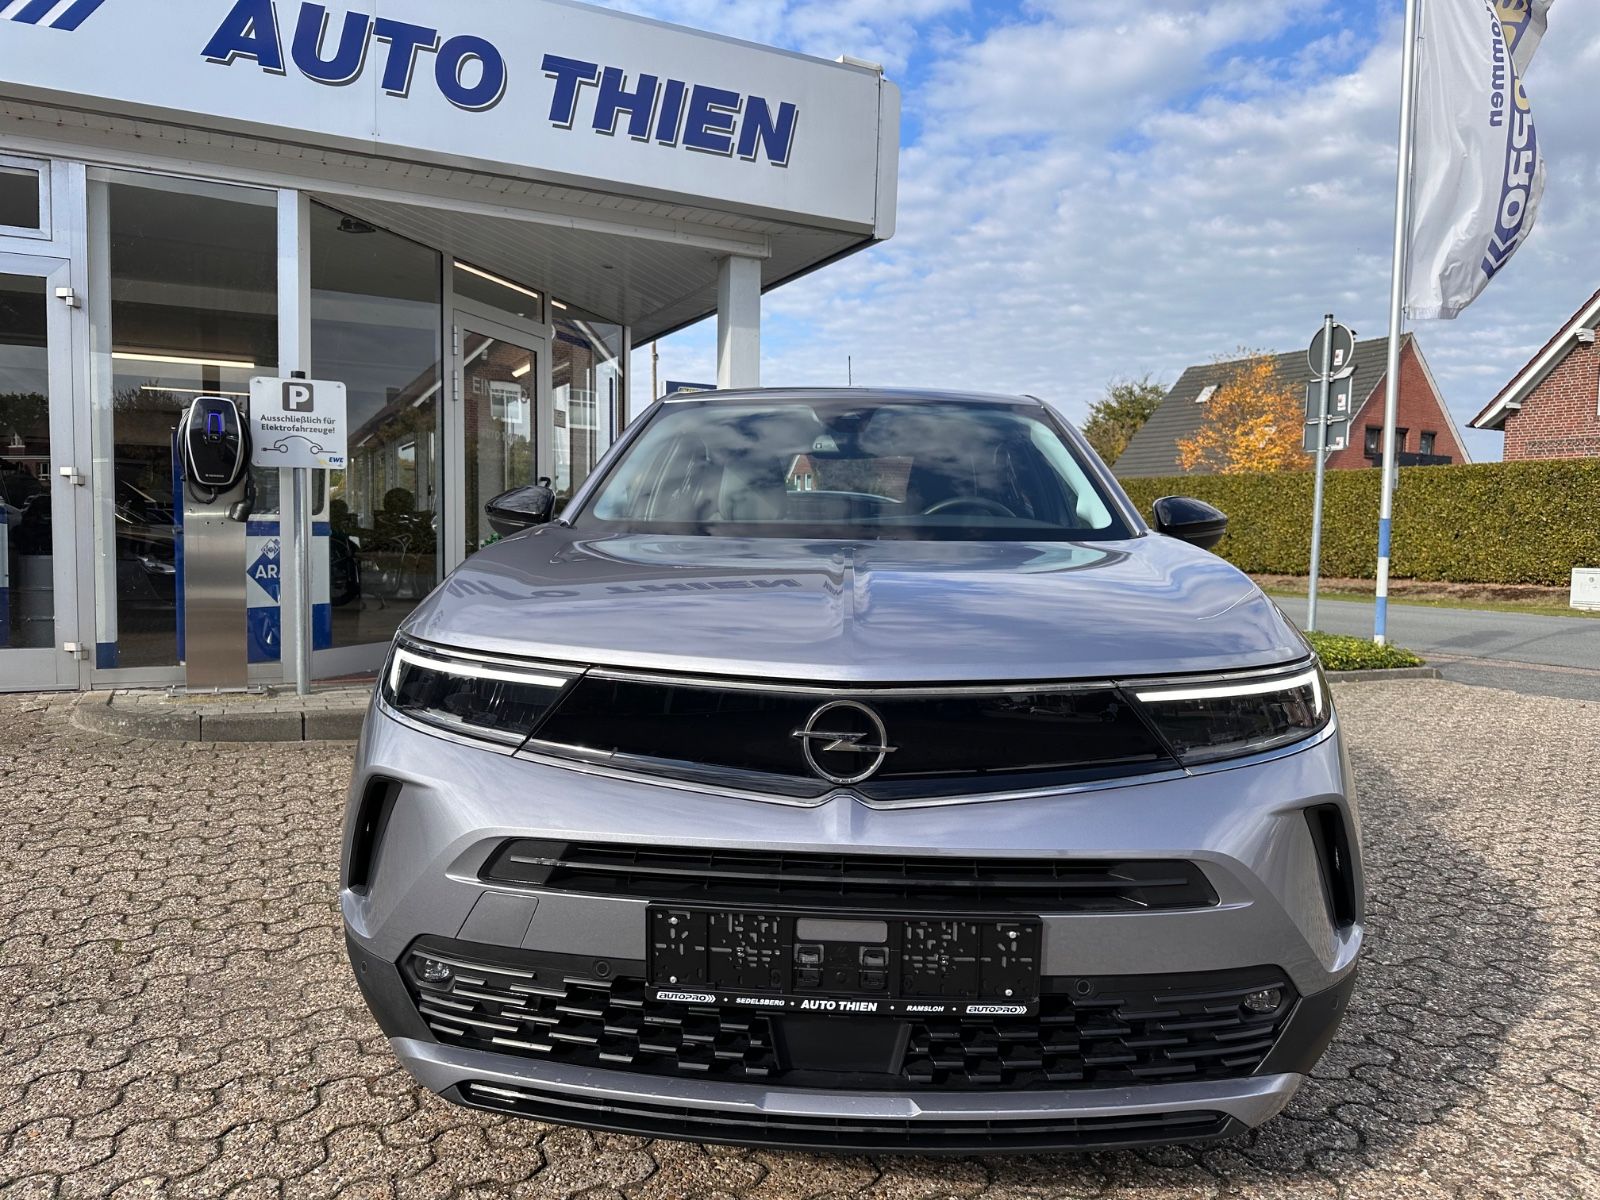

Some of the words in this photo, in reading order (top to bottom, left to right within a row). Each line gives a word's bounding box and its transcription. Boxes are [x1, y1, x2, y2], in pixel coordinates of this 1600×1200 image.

[200, 0, 507, 109] AUTO
[540, 53, 799, 167] THIEN
[289, 385, 310, 409] P
[260, 414, 321, 425] Ausschließlich
[323, 416, 336, 425] für
[261, 423, 336, 435] Elektrofahrzeuge!
[255, 564, 280, 579] AR
[735, 997, 785, 1006] SEDELSBERG
[800, 999, 836, 1011] AUTO
[838, 1001, 878, 1012] THIEN
[905, 1004, 945, 1012] RAMSLOH
